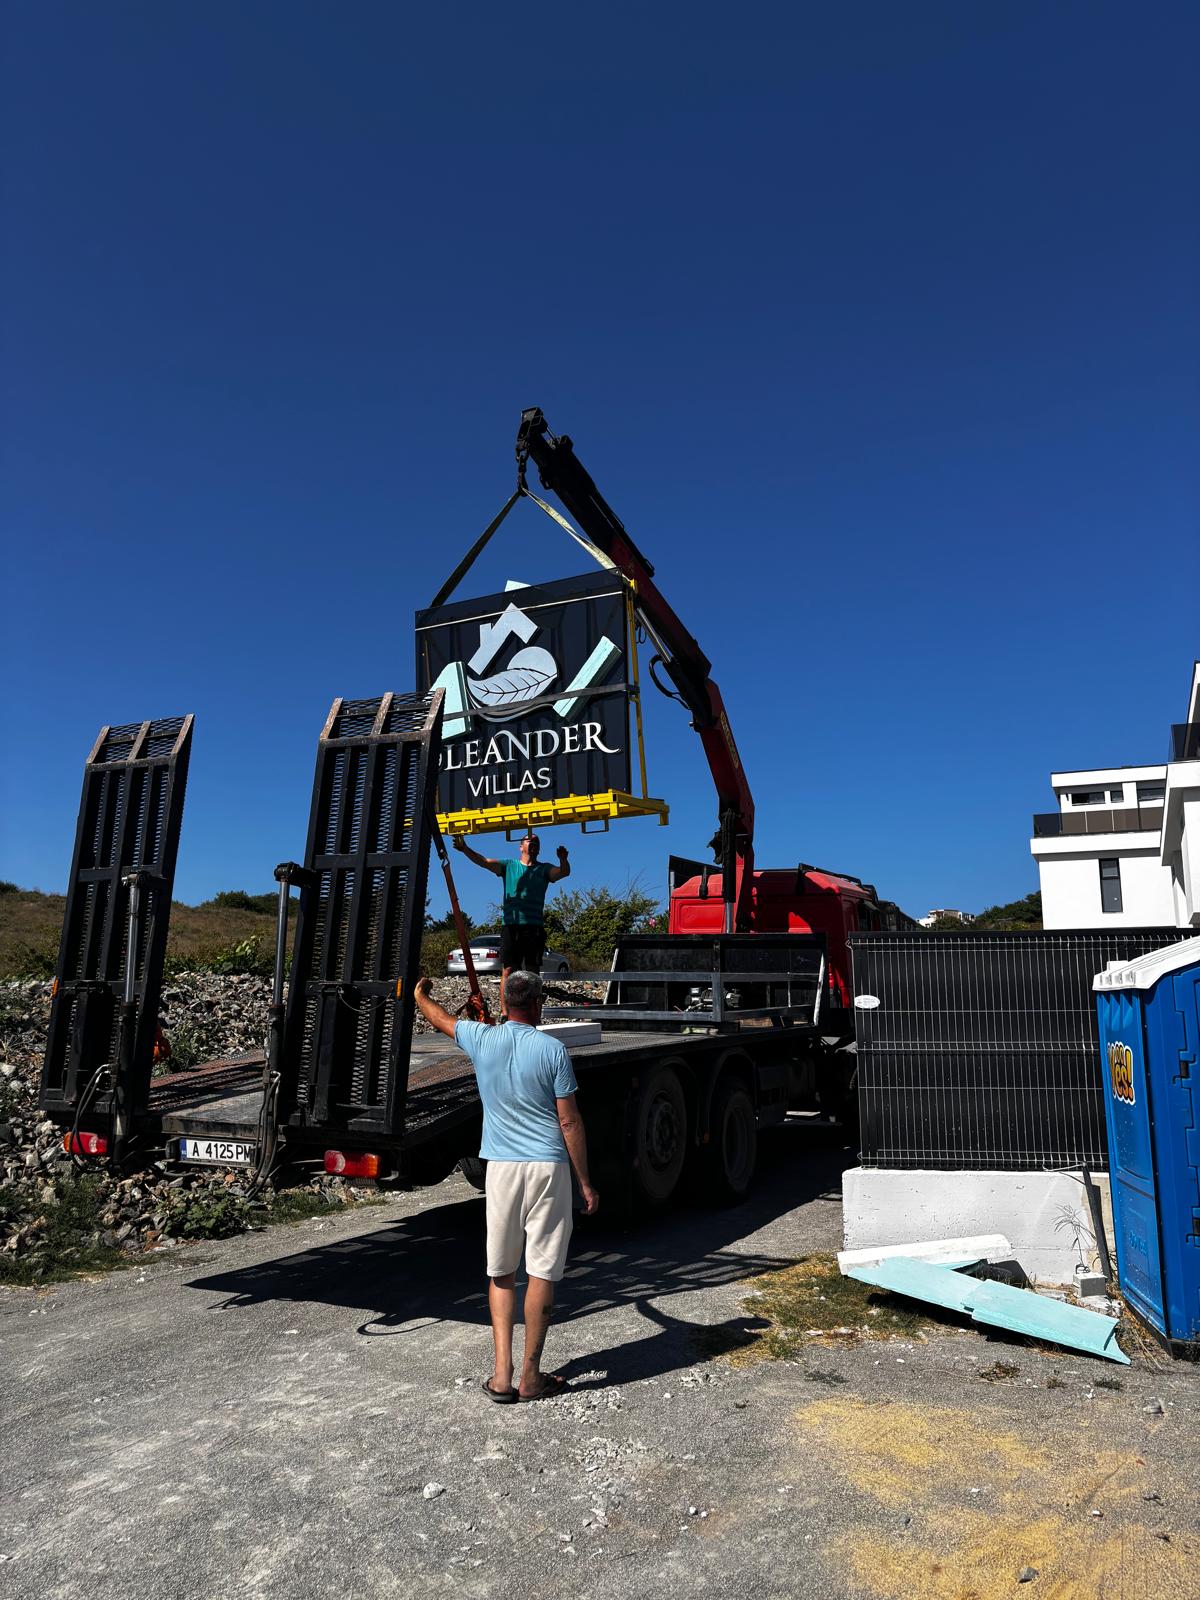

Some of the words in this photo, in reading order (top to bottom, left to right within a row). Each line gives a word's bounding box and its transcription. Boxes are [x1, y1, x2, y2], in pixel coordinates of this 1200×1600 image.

[438, 721, 621, 771] LEANDER
[468, 767, 551, 797] VILLAS
[192, 1142, 200, 1157] A
[205, 1143, 233, 1159] 4125
